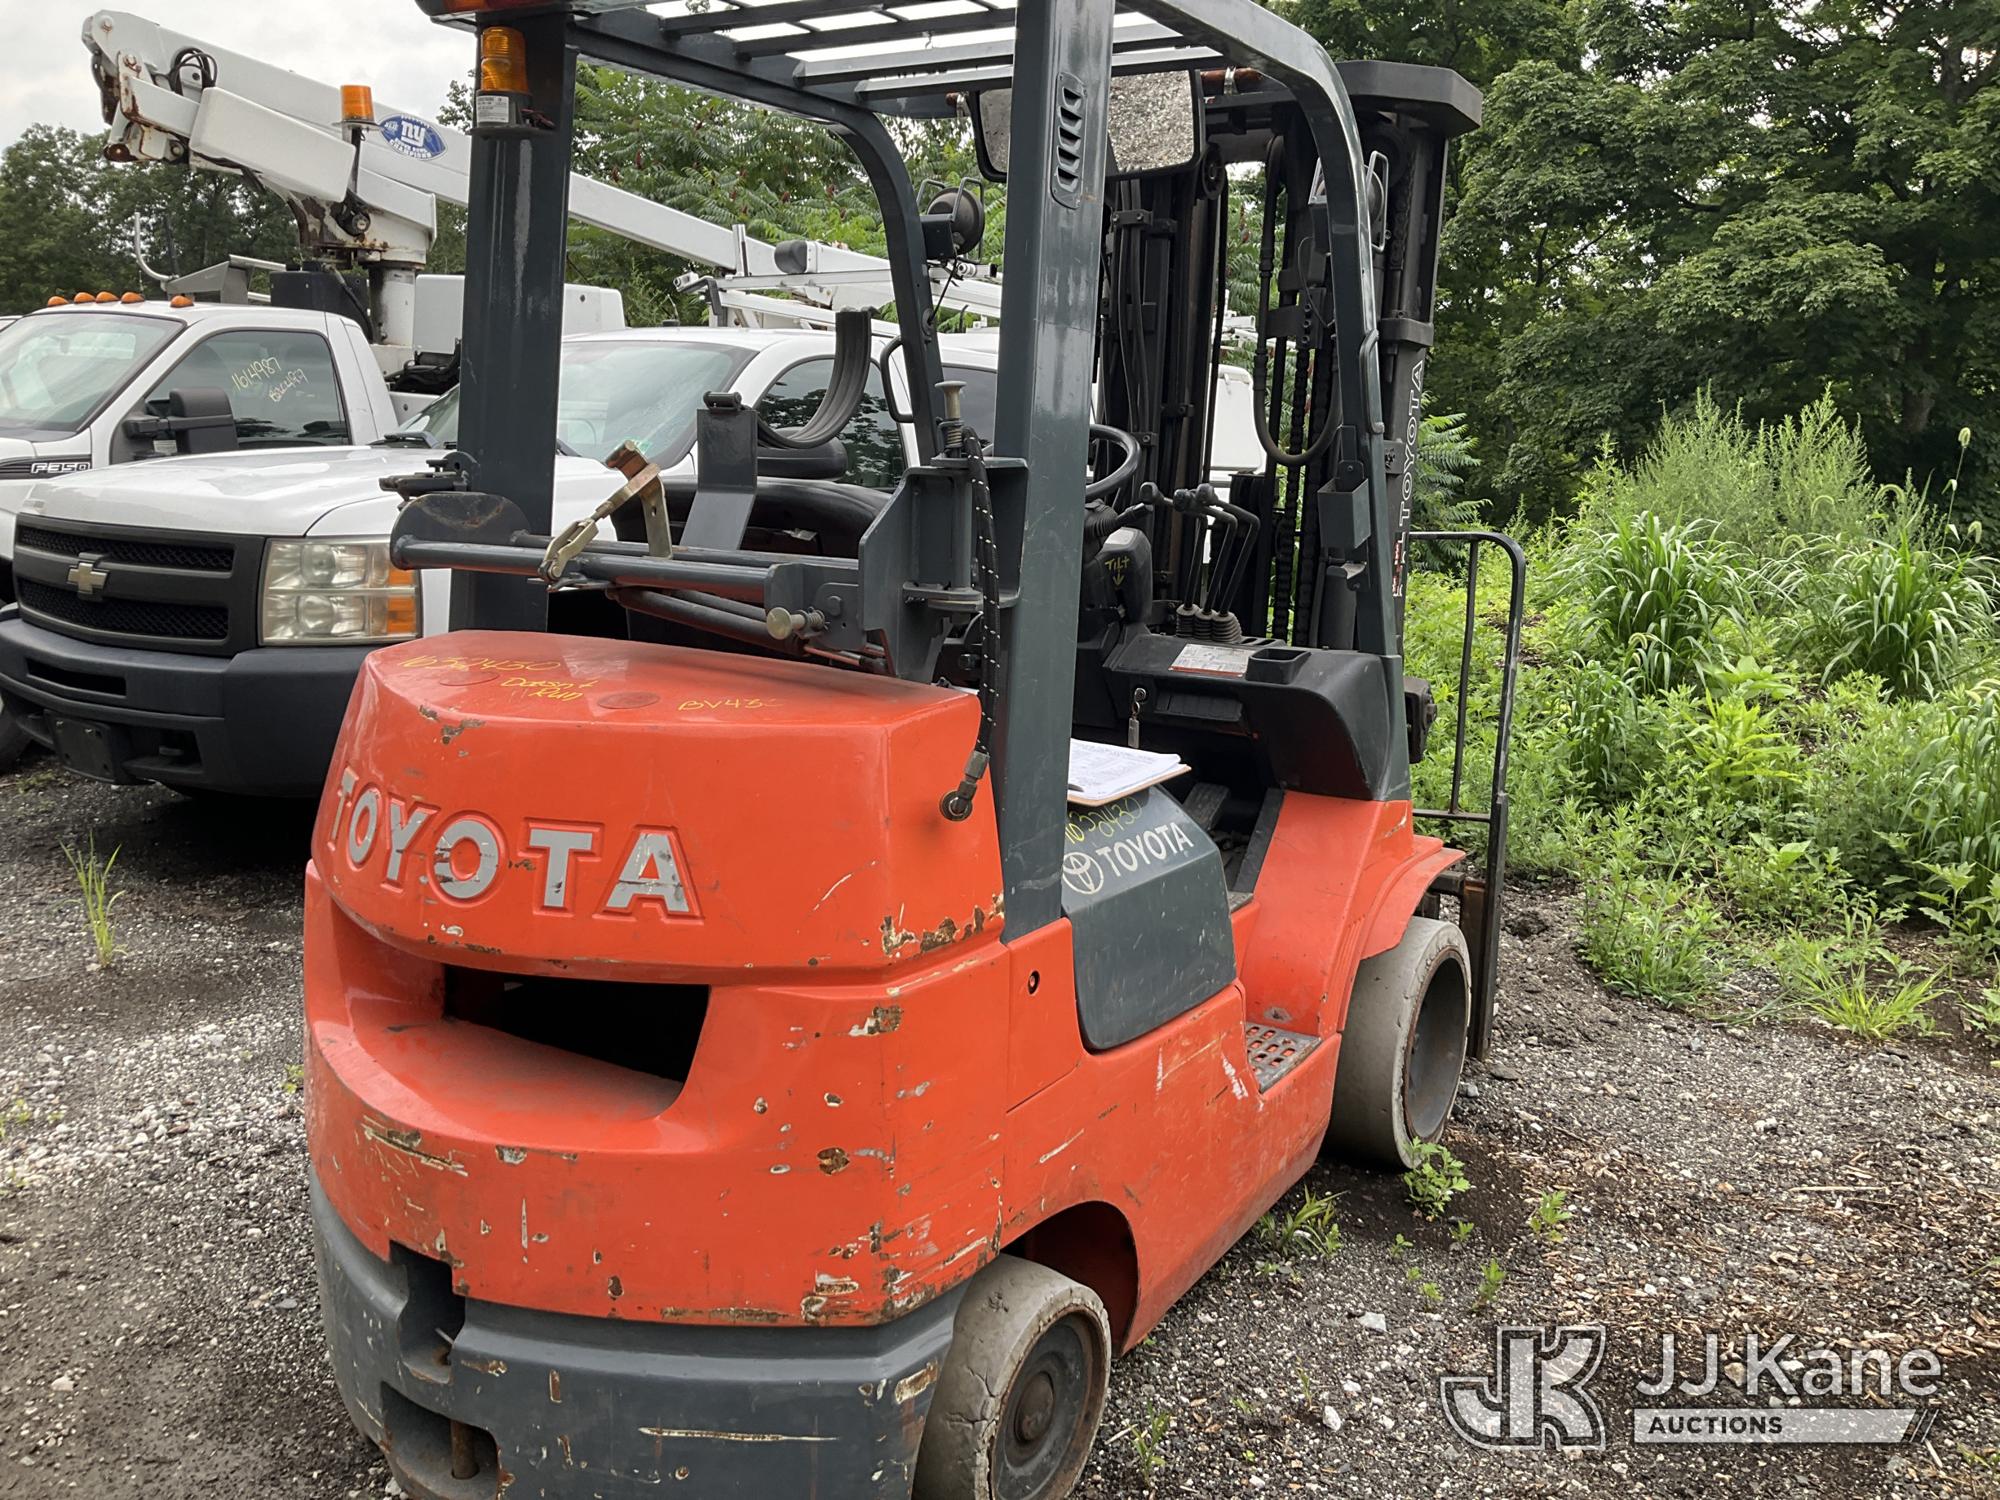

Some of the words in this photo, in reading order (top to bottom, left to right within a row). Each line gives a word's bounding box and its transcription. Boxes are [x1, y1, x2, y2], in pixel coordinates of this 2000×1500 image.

[1399, 360, 1425, 527] TOYOTA
[330, 765, 694, 915] TOYOTA
[1095, 822, 1194, 877] TOYOTA
